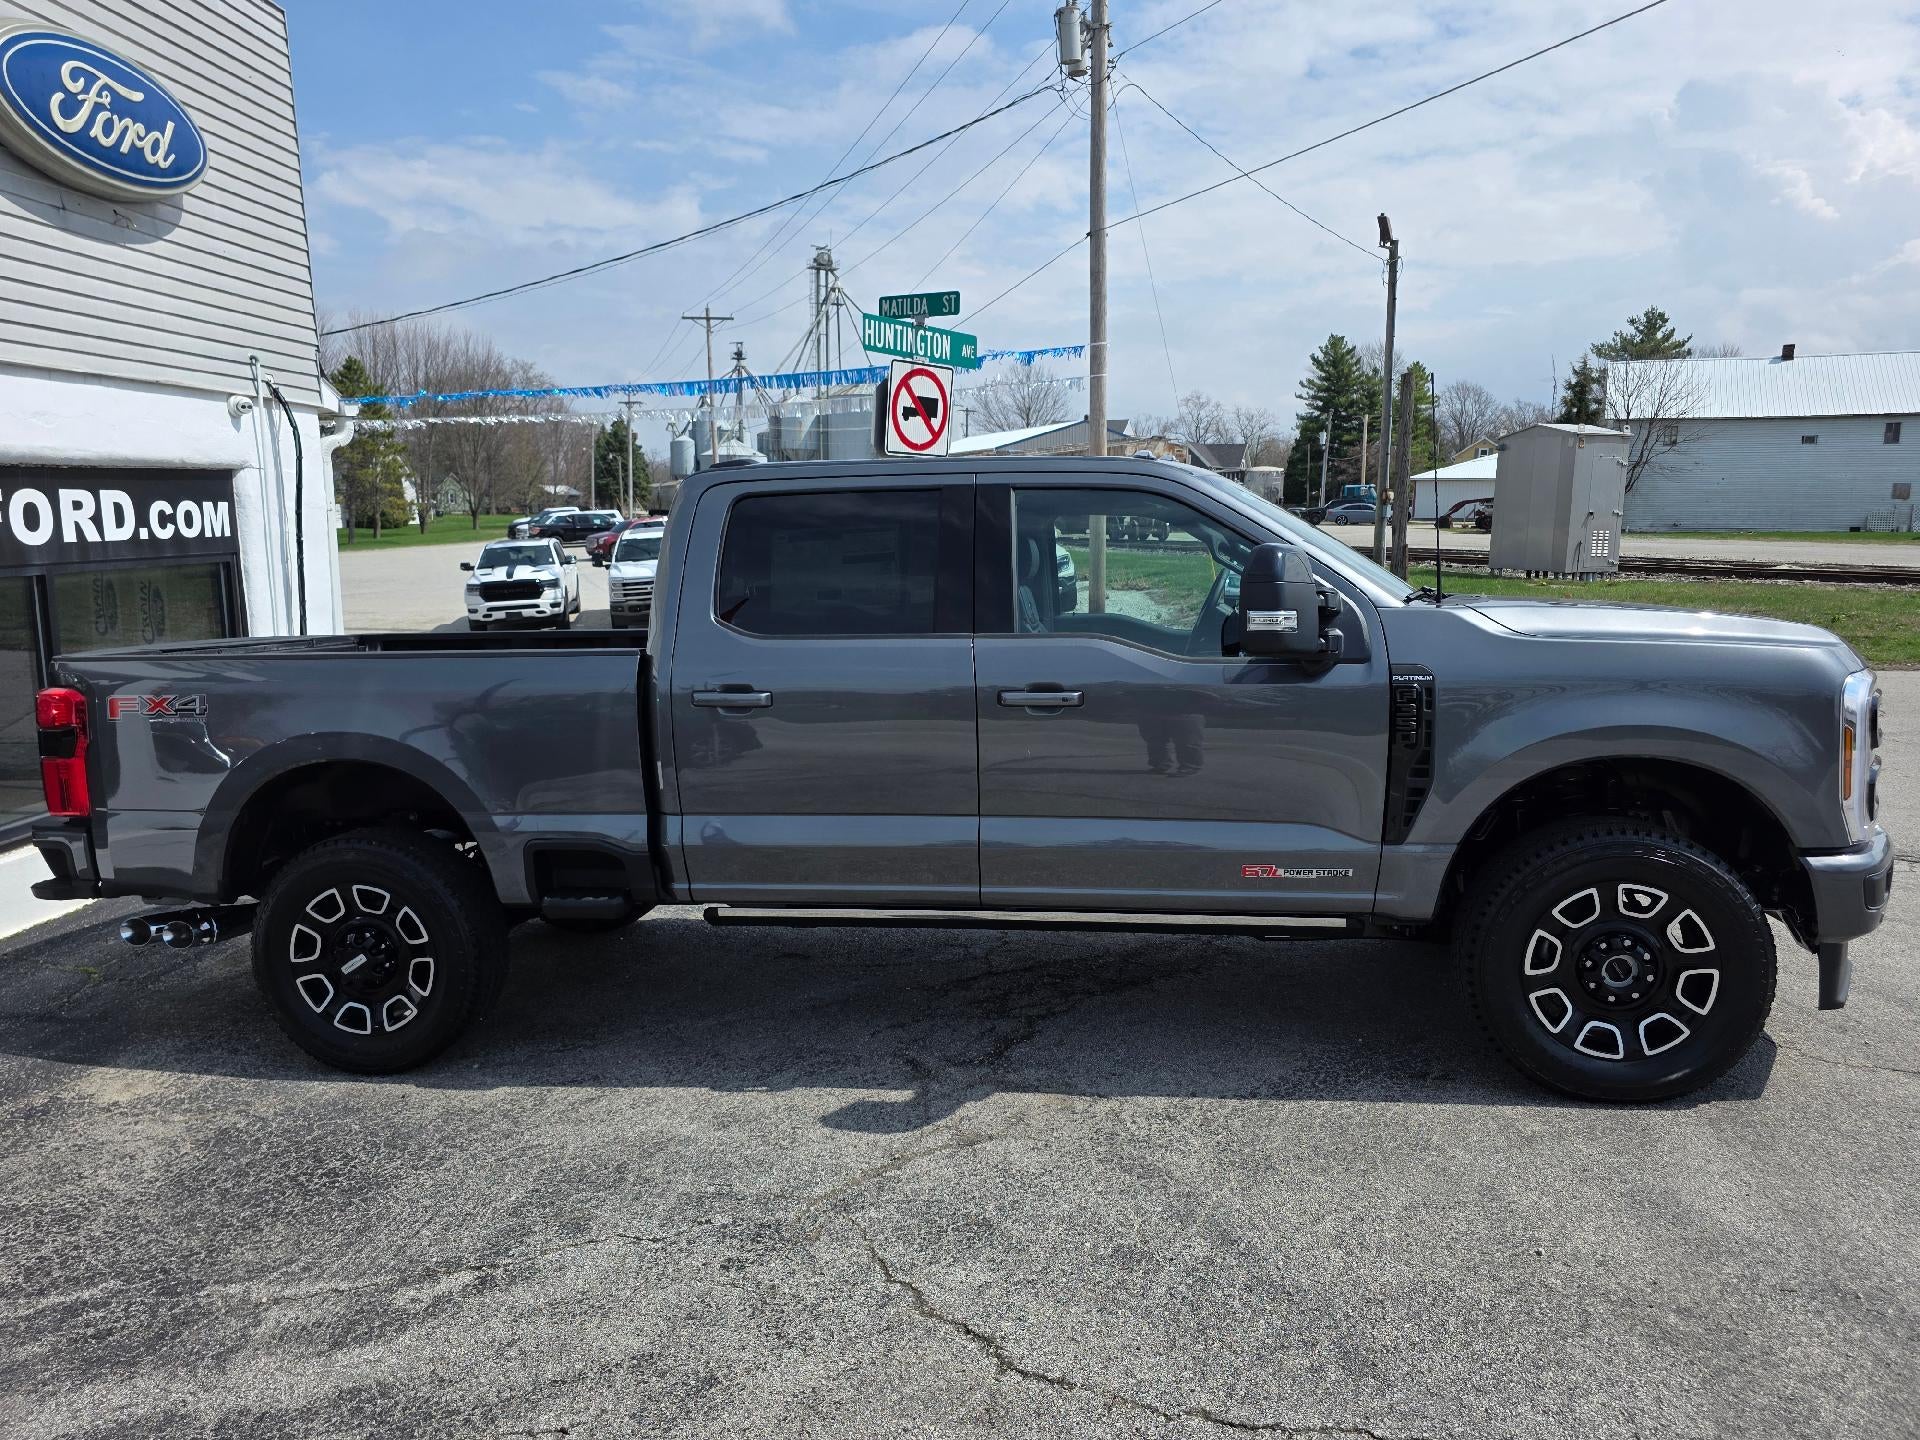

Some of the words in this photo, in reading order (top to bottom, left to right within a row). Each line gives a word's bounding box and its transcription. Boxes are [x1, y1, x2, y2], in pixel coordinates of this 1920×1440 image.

[50, 60, 175, 168] Ford
[881, 297, 929, 317] MATILDA
[942, 295, 957, 313] ST
[865, 319, 951, 360] HUNTINGTON
[961, 344, 975, 359] AVE
[0, 488, 231, 546] ORD.COM
[107, 694, 209, 722] FX4
